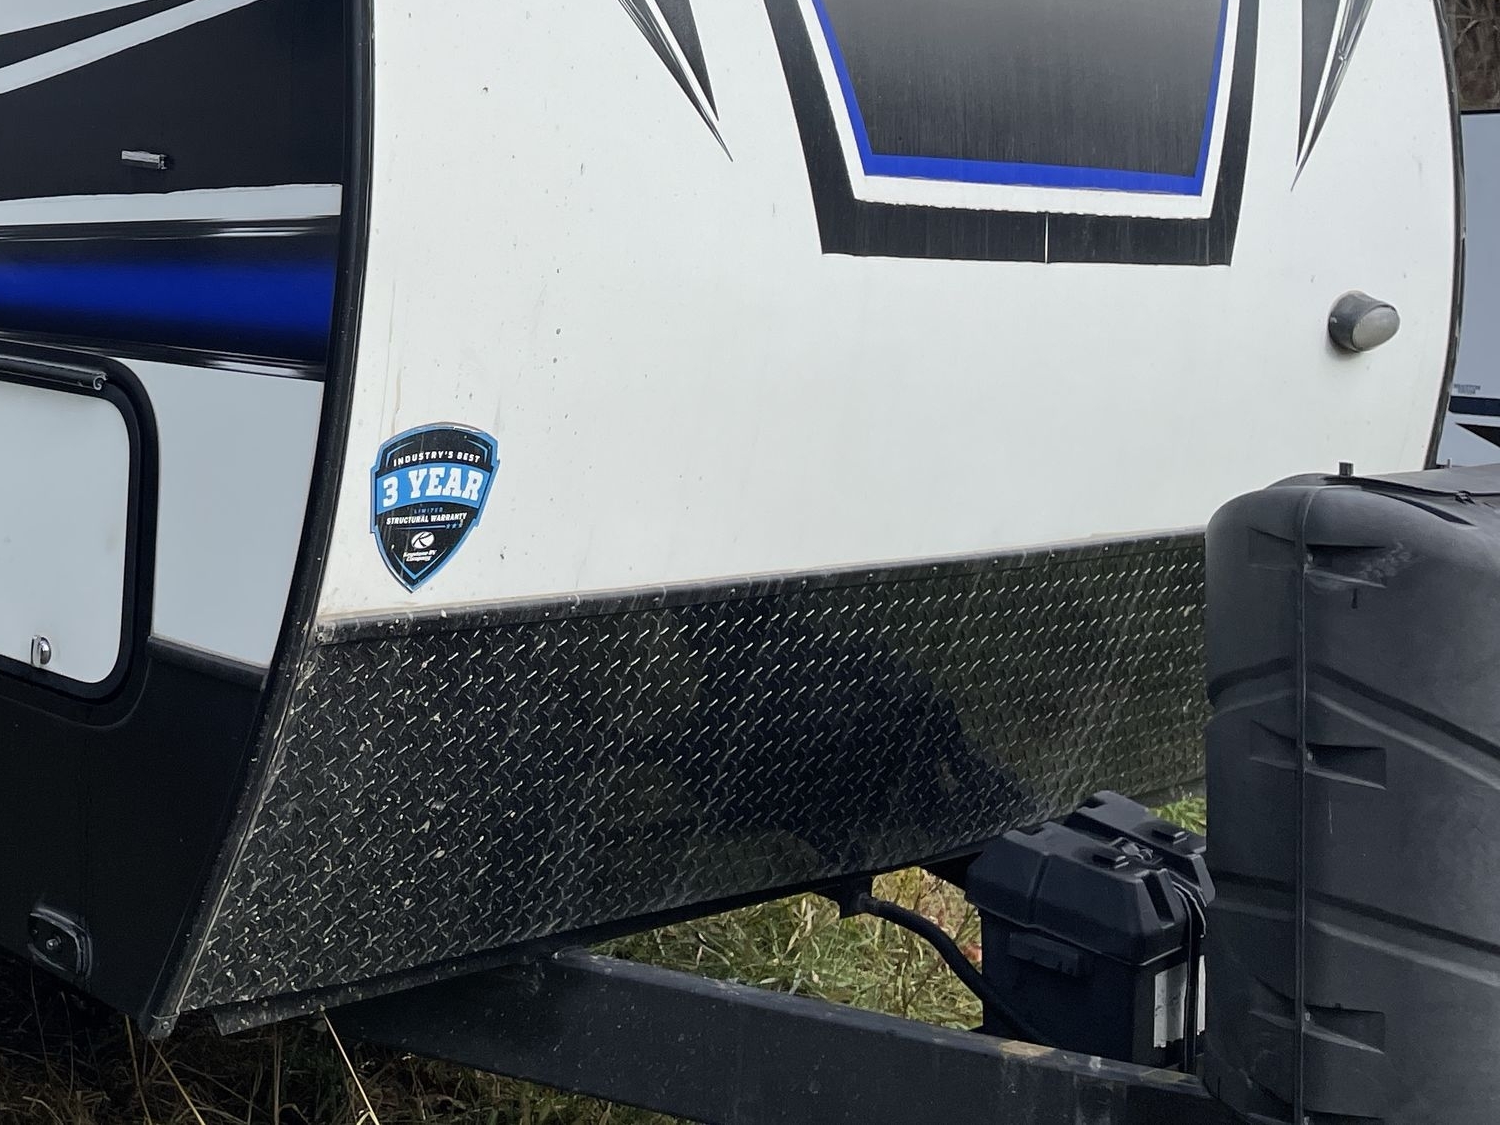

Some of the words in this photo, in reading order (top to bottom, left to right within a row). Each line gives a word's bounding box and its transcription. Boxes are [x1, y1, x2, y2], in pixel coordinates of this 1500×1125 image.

[393, 450, 454, 467] INDUSTRY'S
[456, 451, 481, 463] BEST
[382, 476, 399, 508] 3
[408, 467, 484, 501] YEAR
[386, 515, 429, 525] STRUCTURAL
[430, 512, 468, 522] WARRANTY
